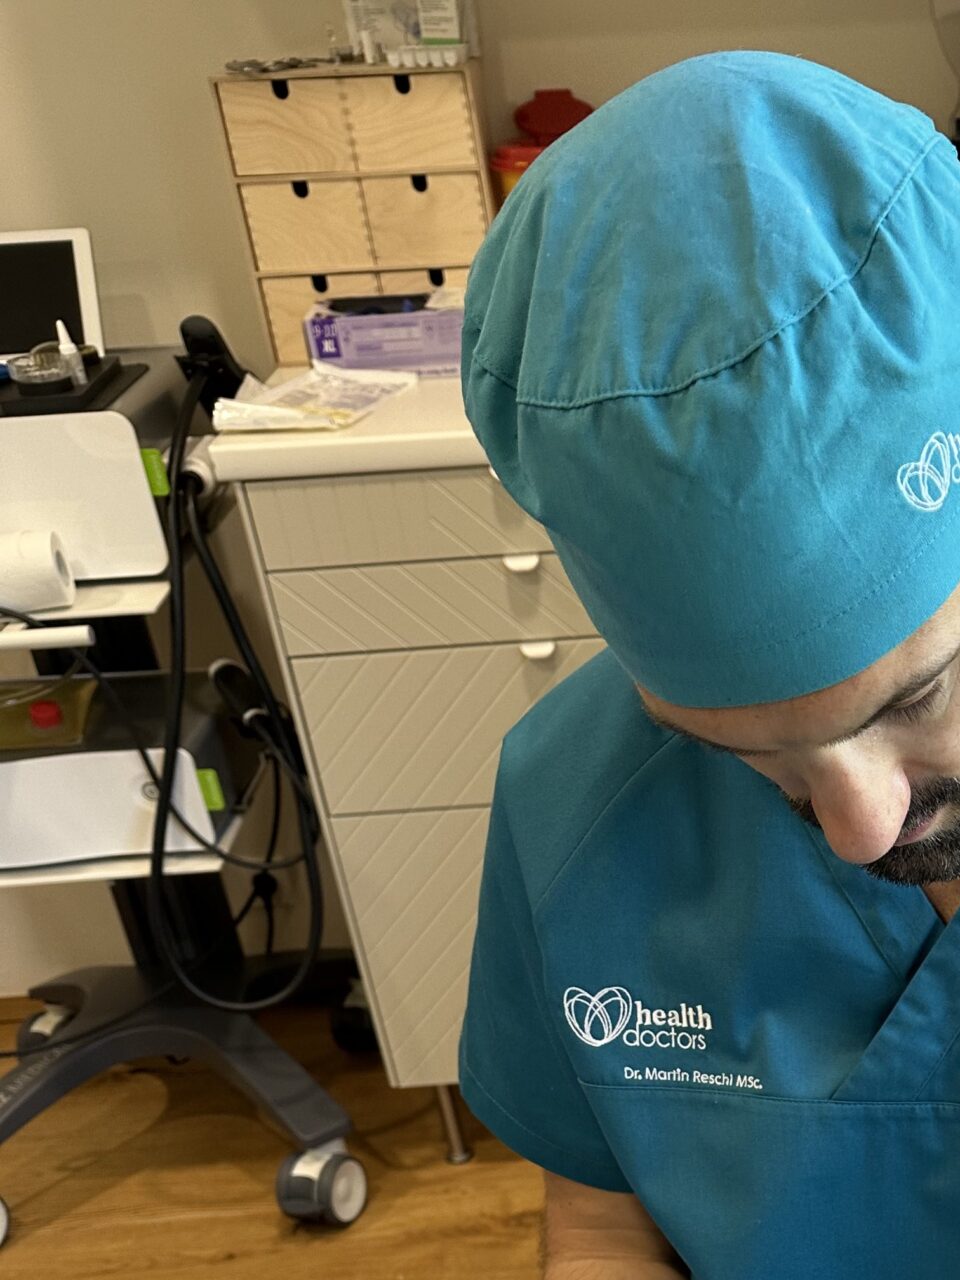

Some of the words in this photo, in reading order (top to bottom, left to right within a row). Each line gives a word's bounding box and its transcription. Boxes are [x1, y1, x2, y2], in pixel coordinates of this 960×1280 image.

[634, 1001, 712, 1030] health
[623, 1022, 707, 1050] doctors
[624, 1066, 643, 1080] Dr.
[645, 1067, 690, 1082] Martin
[736, 1075, 763, 1090] MSc.
